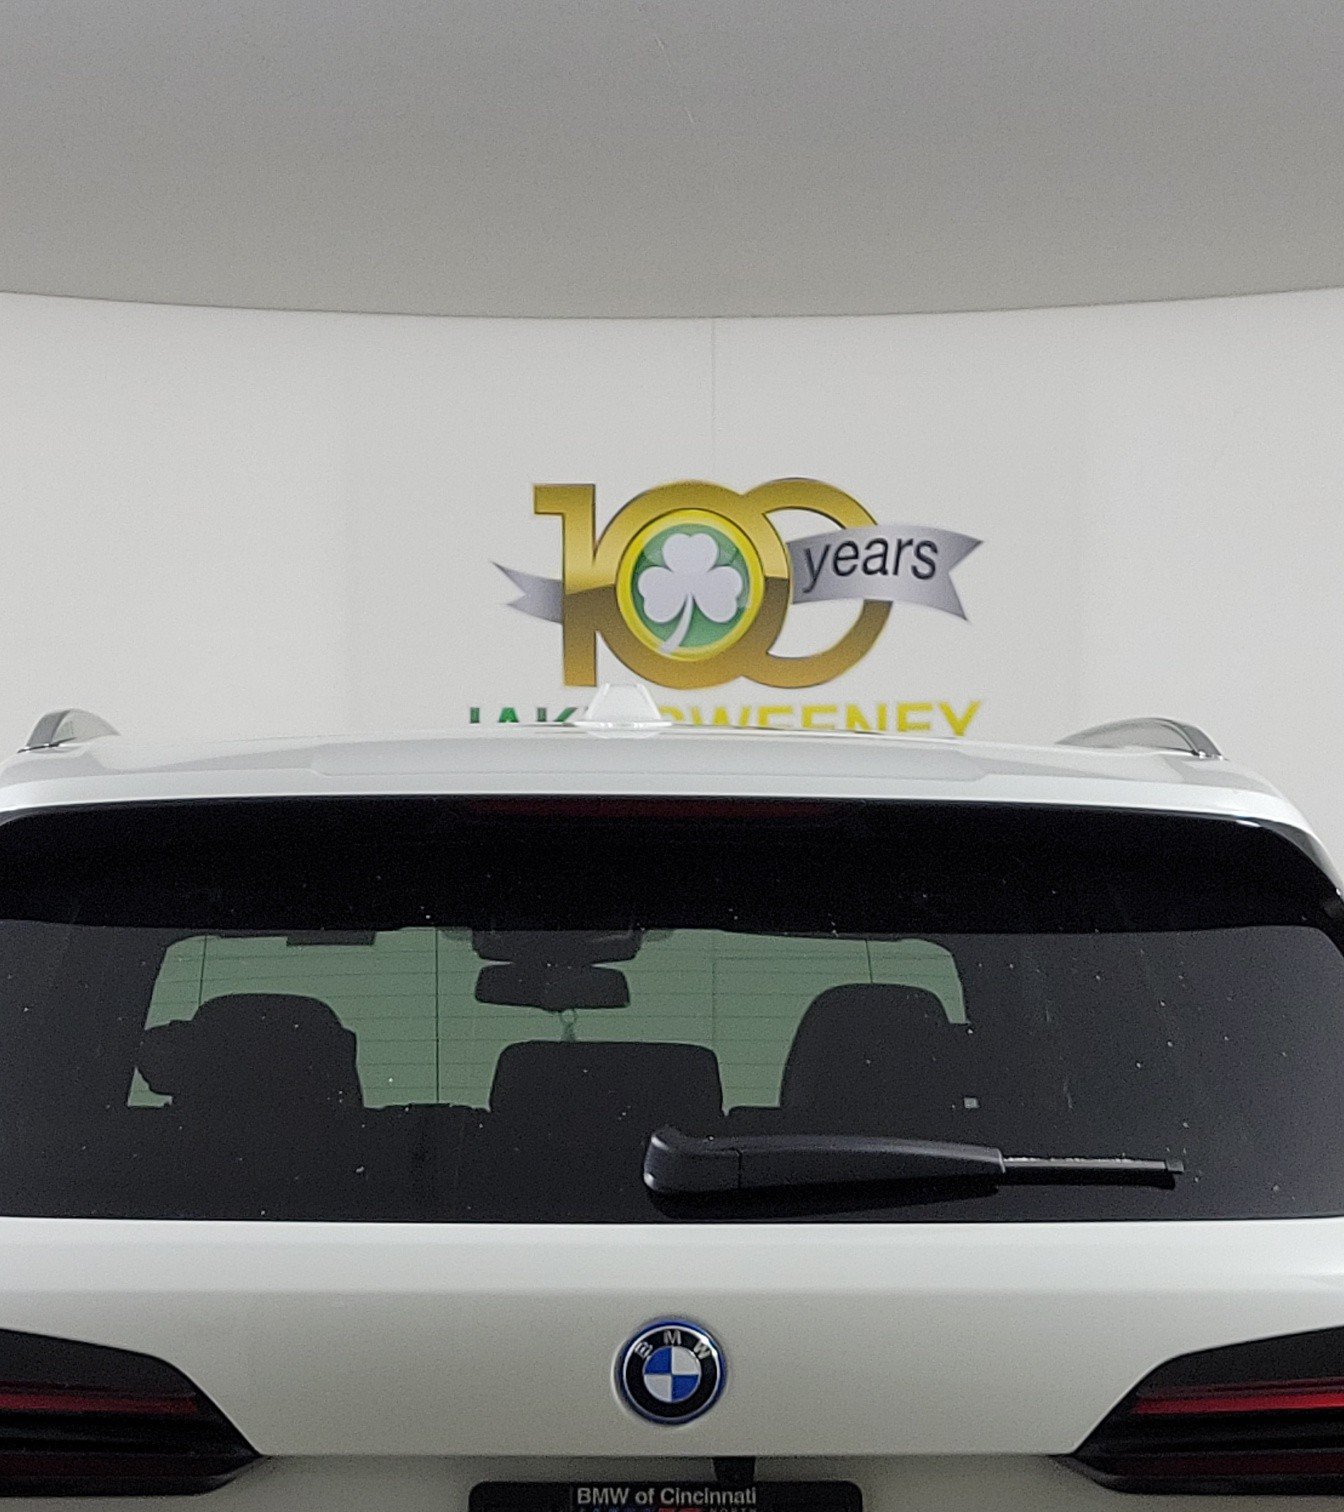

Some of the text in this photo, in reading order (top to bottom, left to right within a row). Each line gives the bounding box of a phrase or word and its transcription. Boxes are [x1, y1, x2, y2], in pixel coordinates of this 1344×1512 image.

[803, 537, 939, 594] years
[634, 1329, 711, 1360] BMW
[577, 1487, 757, 1505] BMW of Cincinnati
